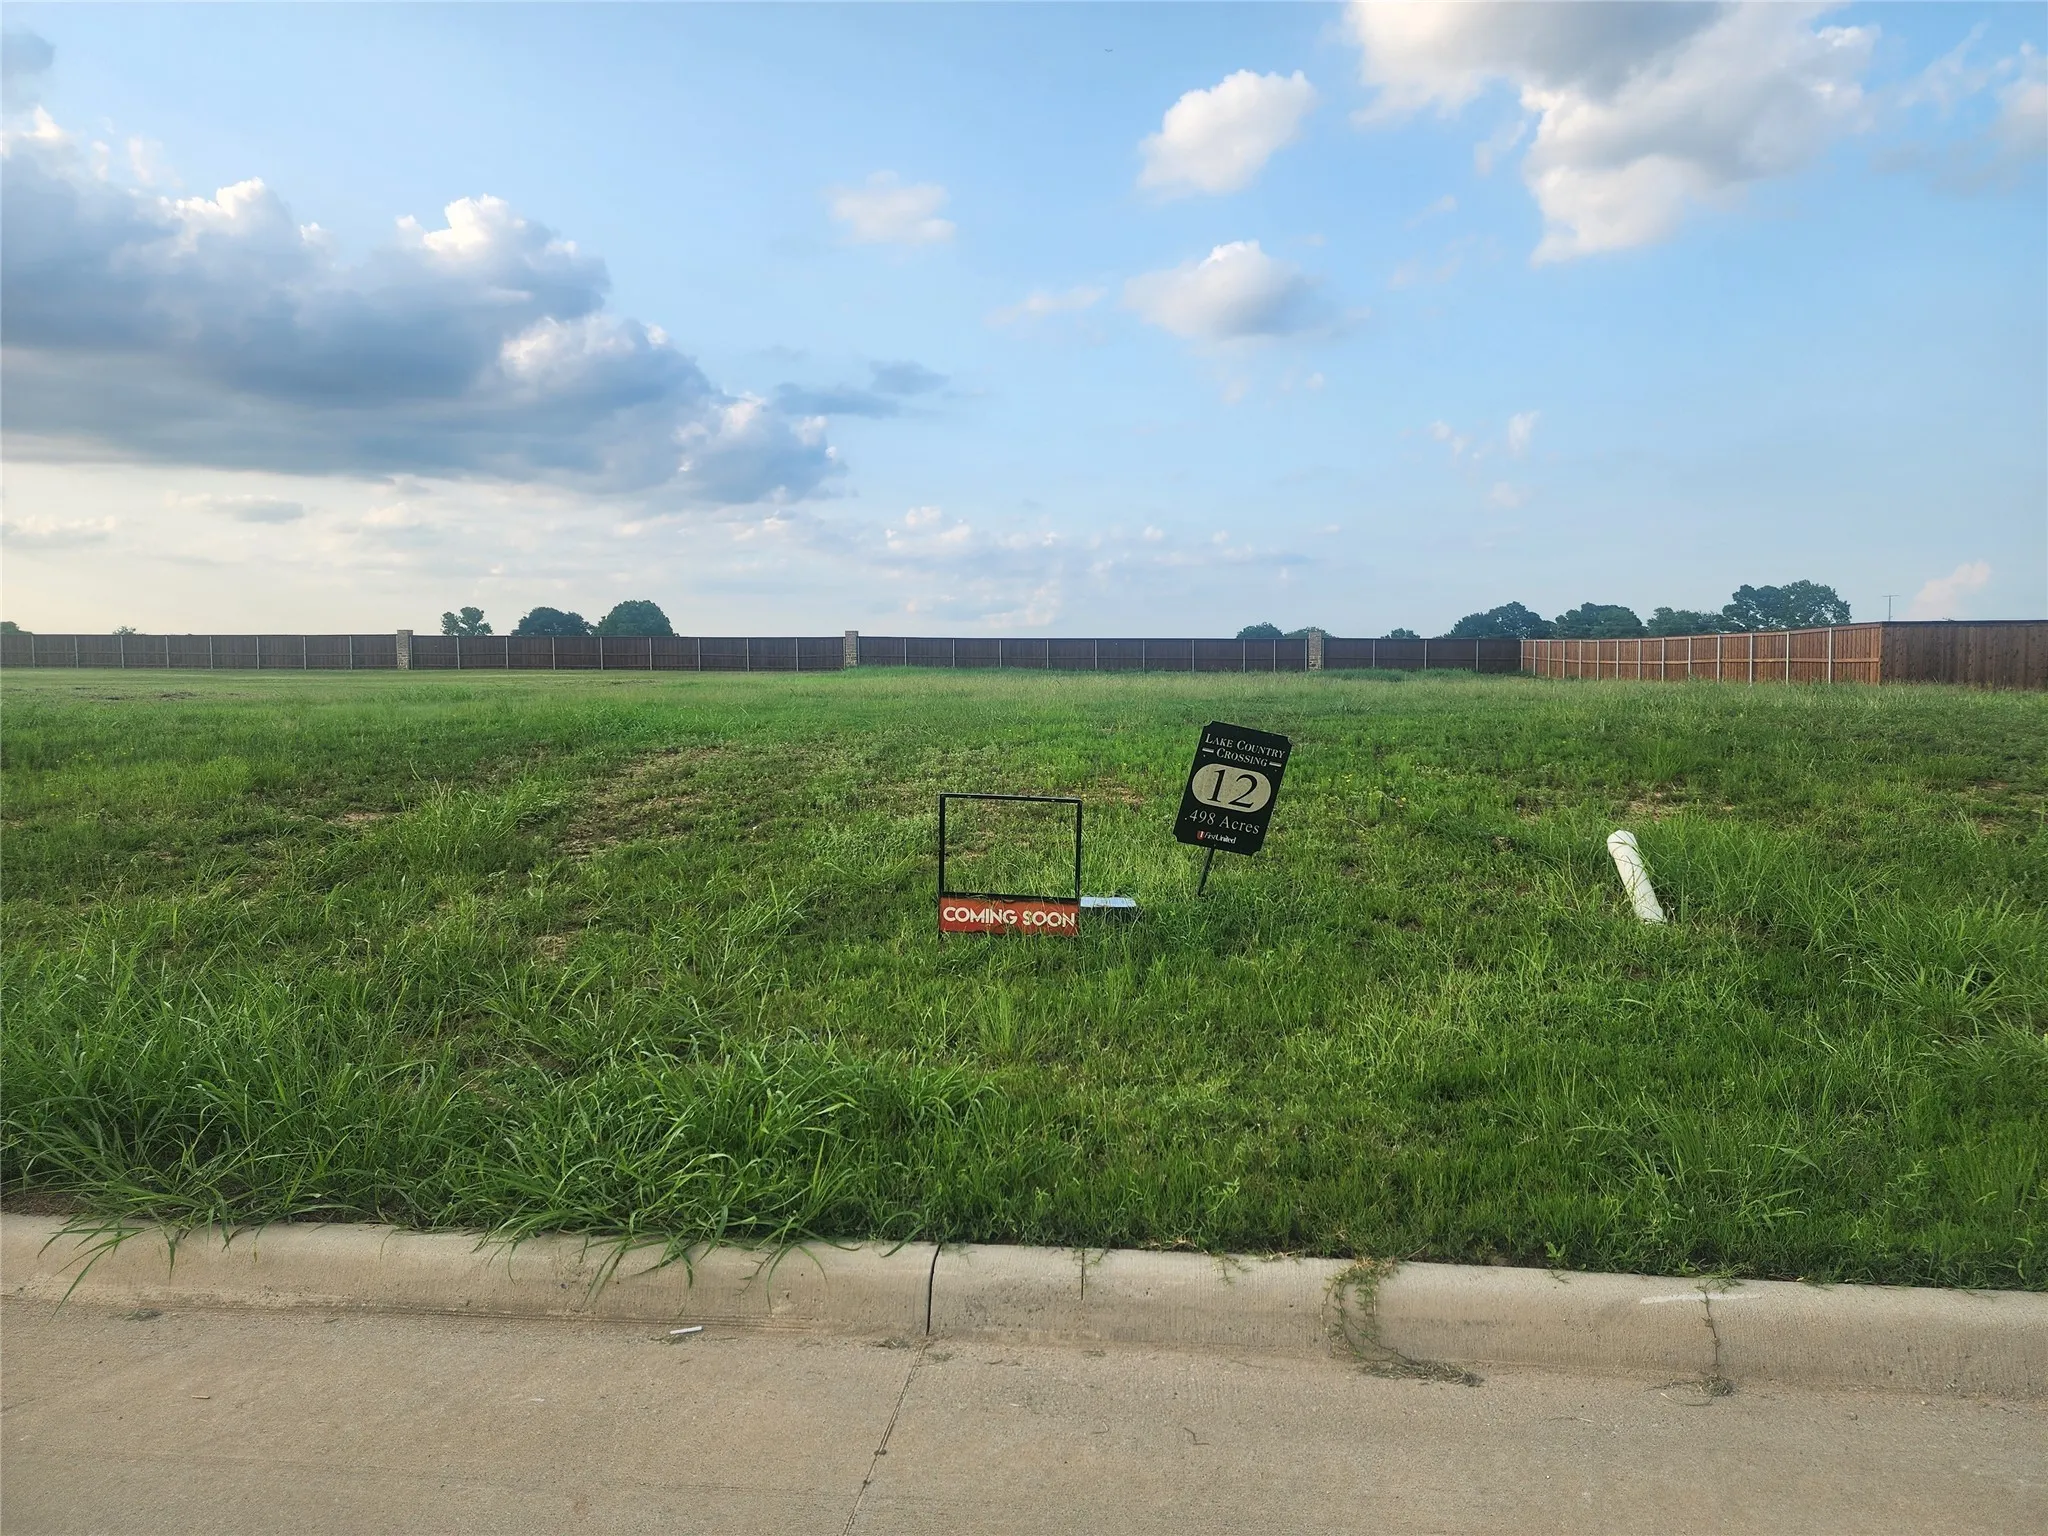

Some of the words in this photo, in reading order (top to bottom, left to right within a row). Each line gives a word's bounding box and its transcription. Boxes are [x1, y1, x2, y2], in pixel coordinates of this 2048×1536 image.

[1204, 733, 1234, 748] LAKE
[1236, 739, 1286, 759] COUNTRY
[1216, 747, 1268, 767] CROSSING
[1207, 769, 1258, 809] 12
[1184, 809, 1216, 826] .498
[1219, 815, 1260, 835] Acres
[943, 906, 1018, 925] COMING
[1022, 910, 1075, 928] SOON
